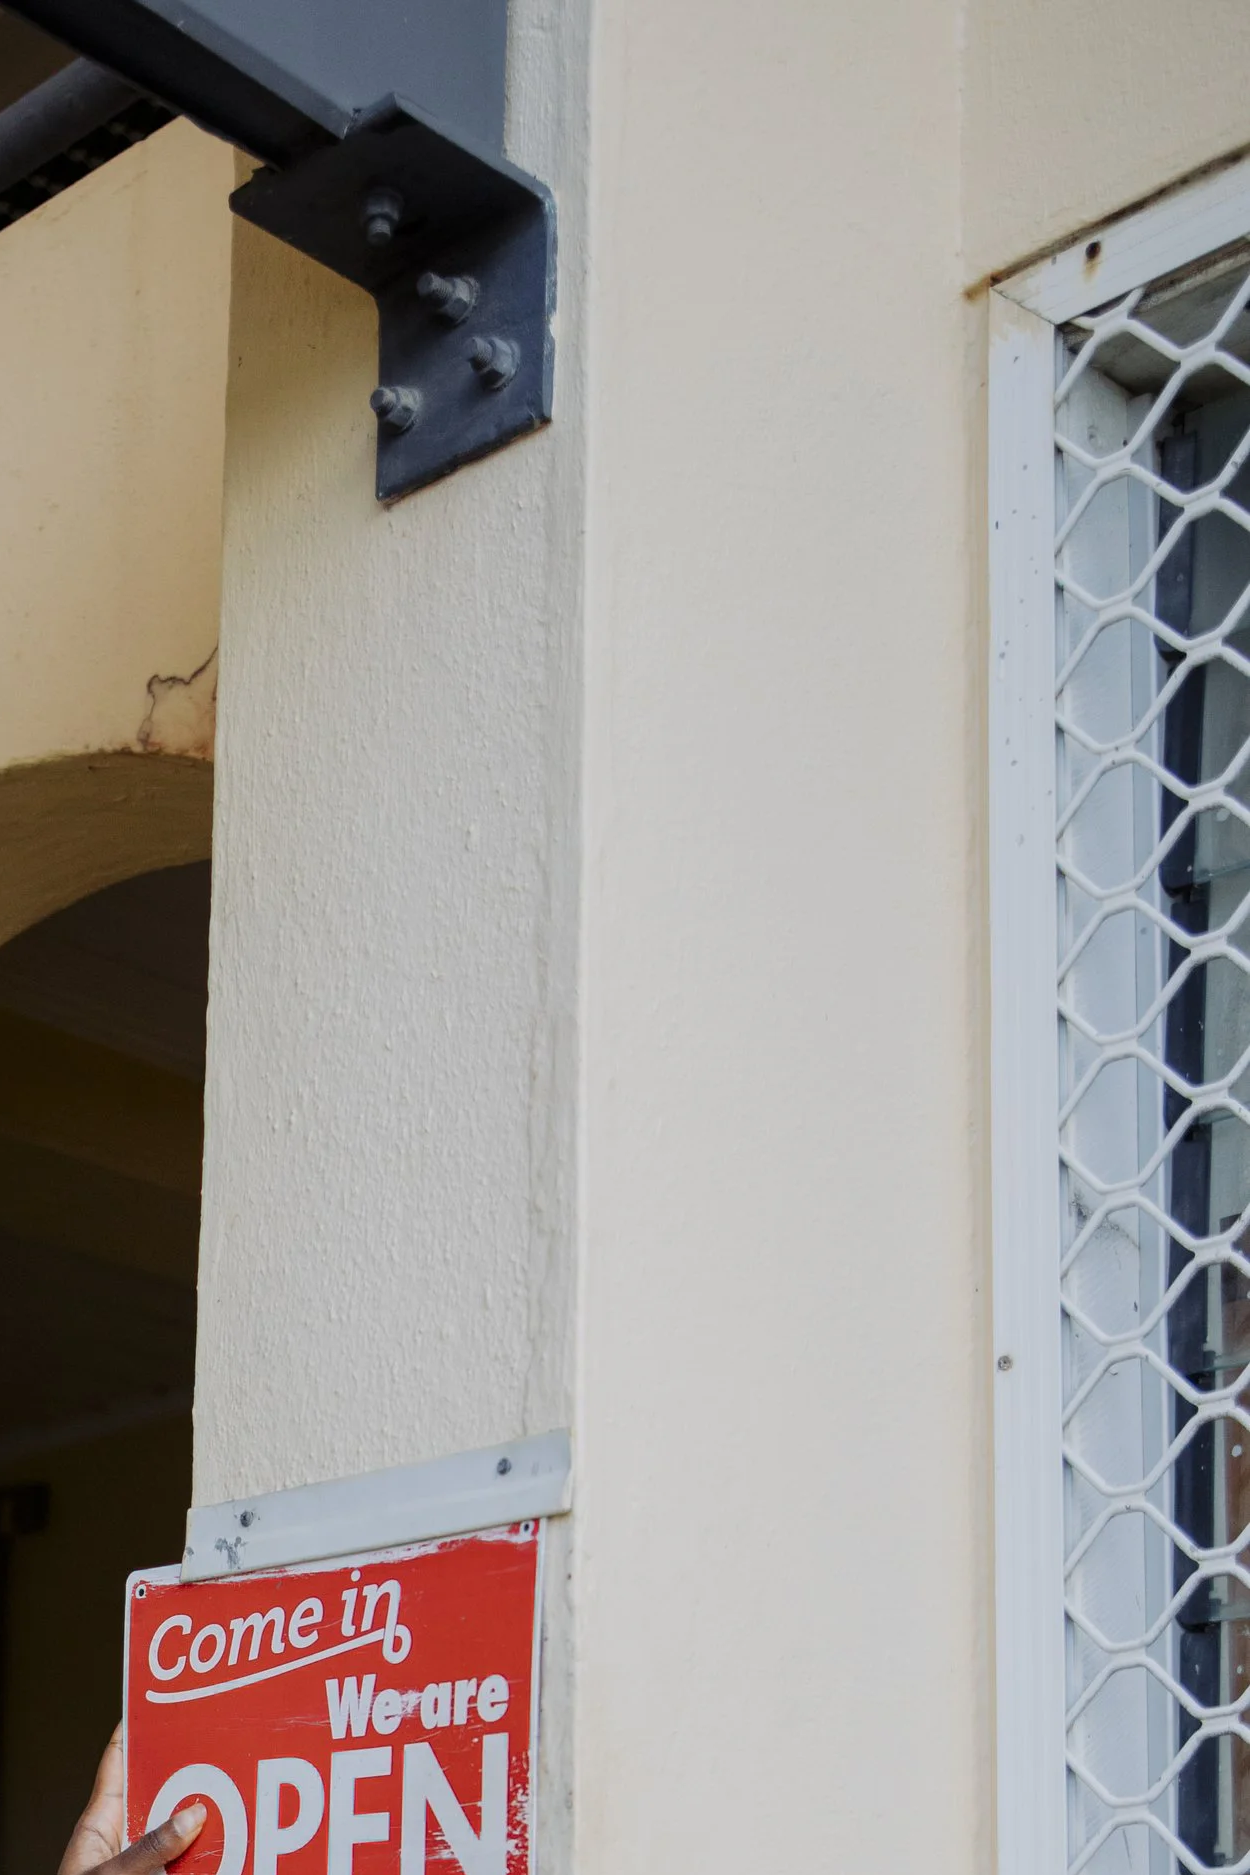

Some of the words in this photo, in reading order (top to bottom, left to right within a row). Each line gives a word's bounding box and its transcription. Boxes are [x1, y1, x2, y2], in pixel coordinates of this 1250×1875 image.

[147, 1597, 324, 1681] Come
[341, 1569, 412, 1664] in
[326, 1674, 402, 1740] We
[420, 1673, 509, 1732] are
